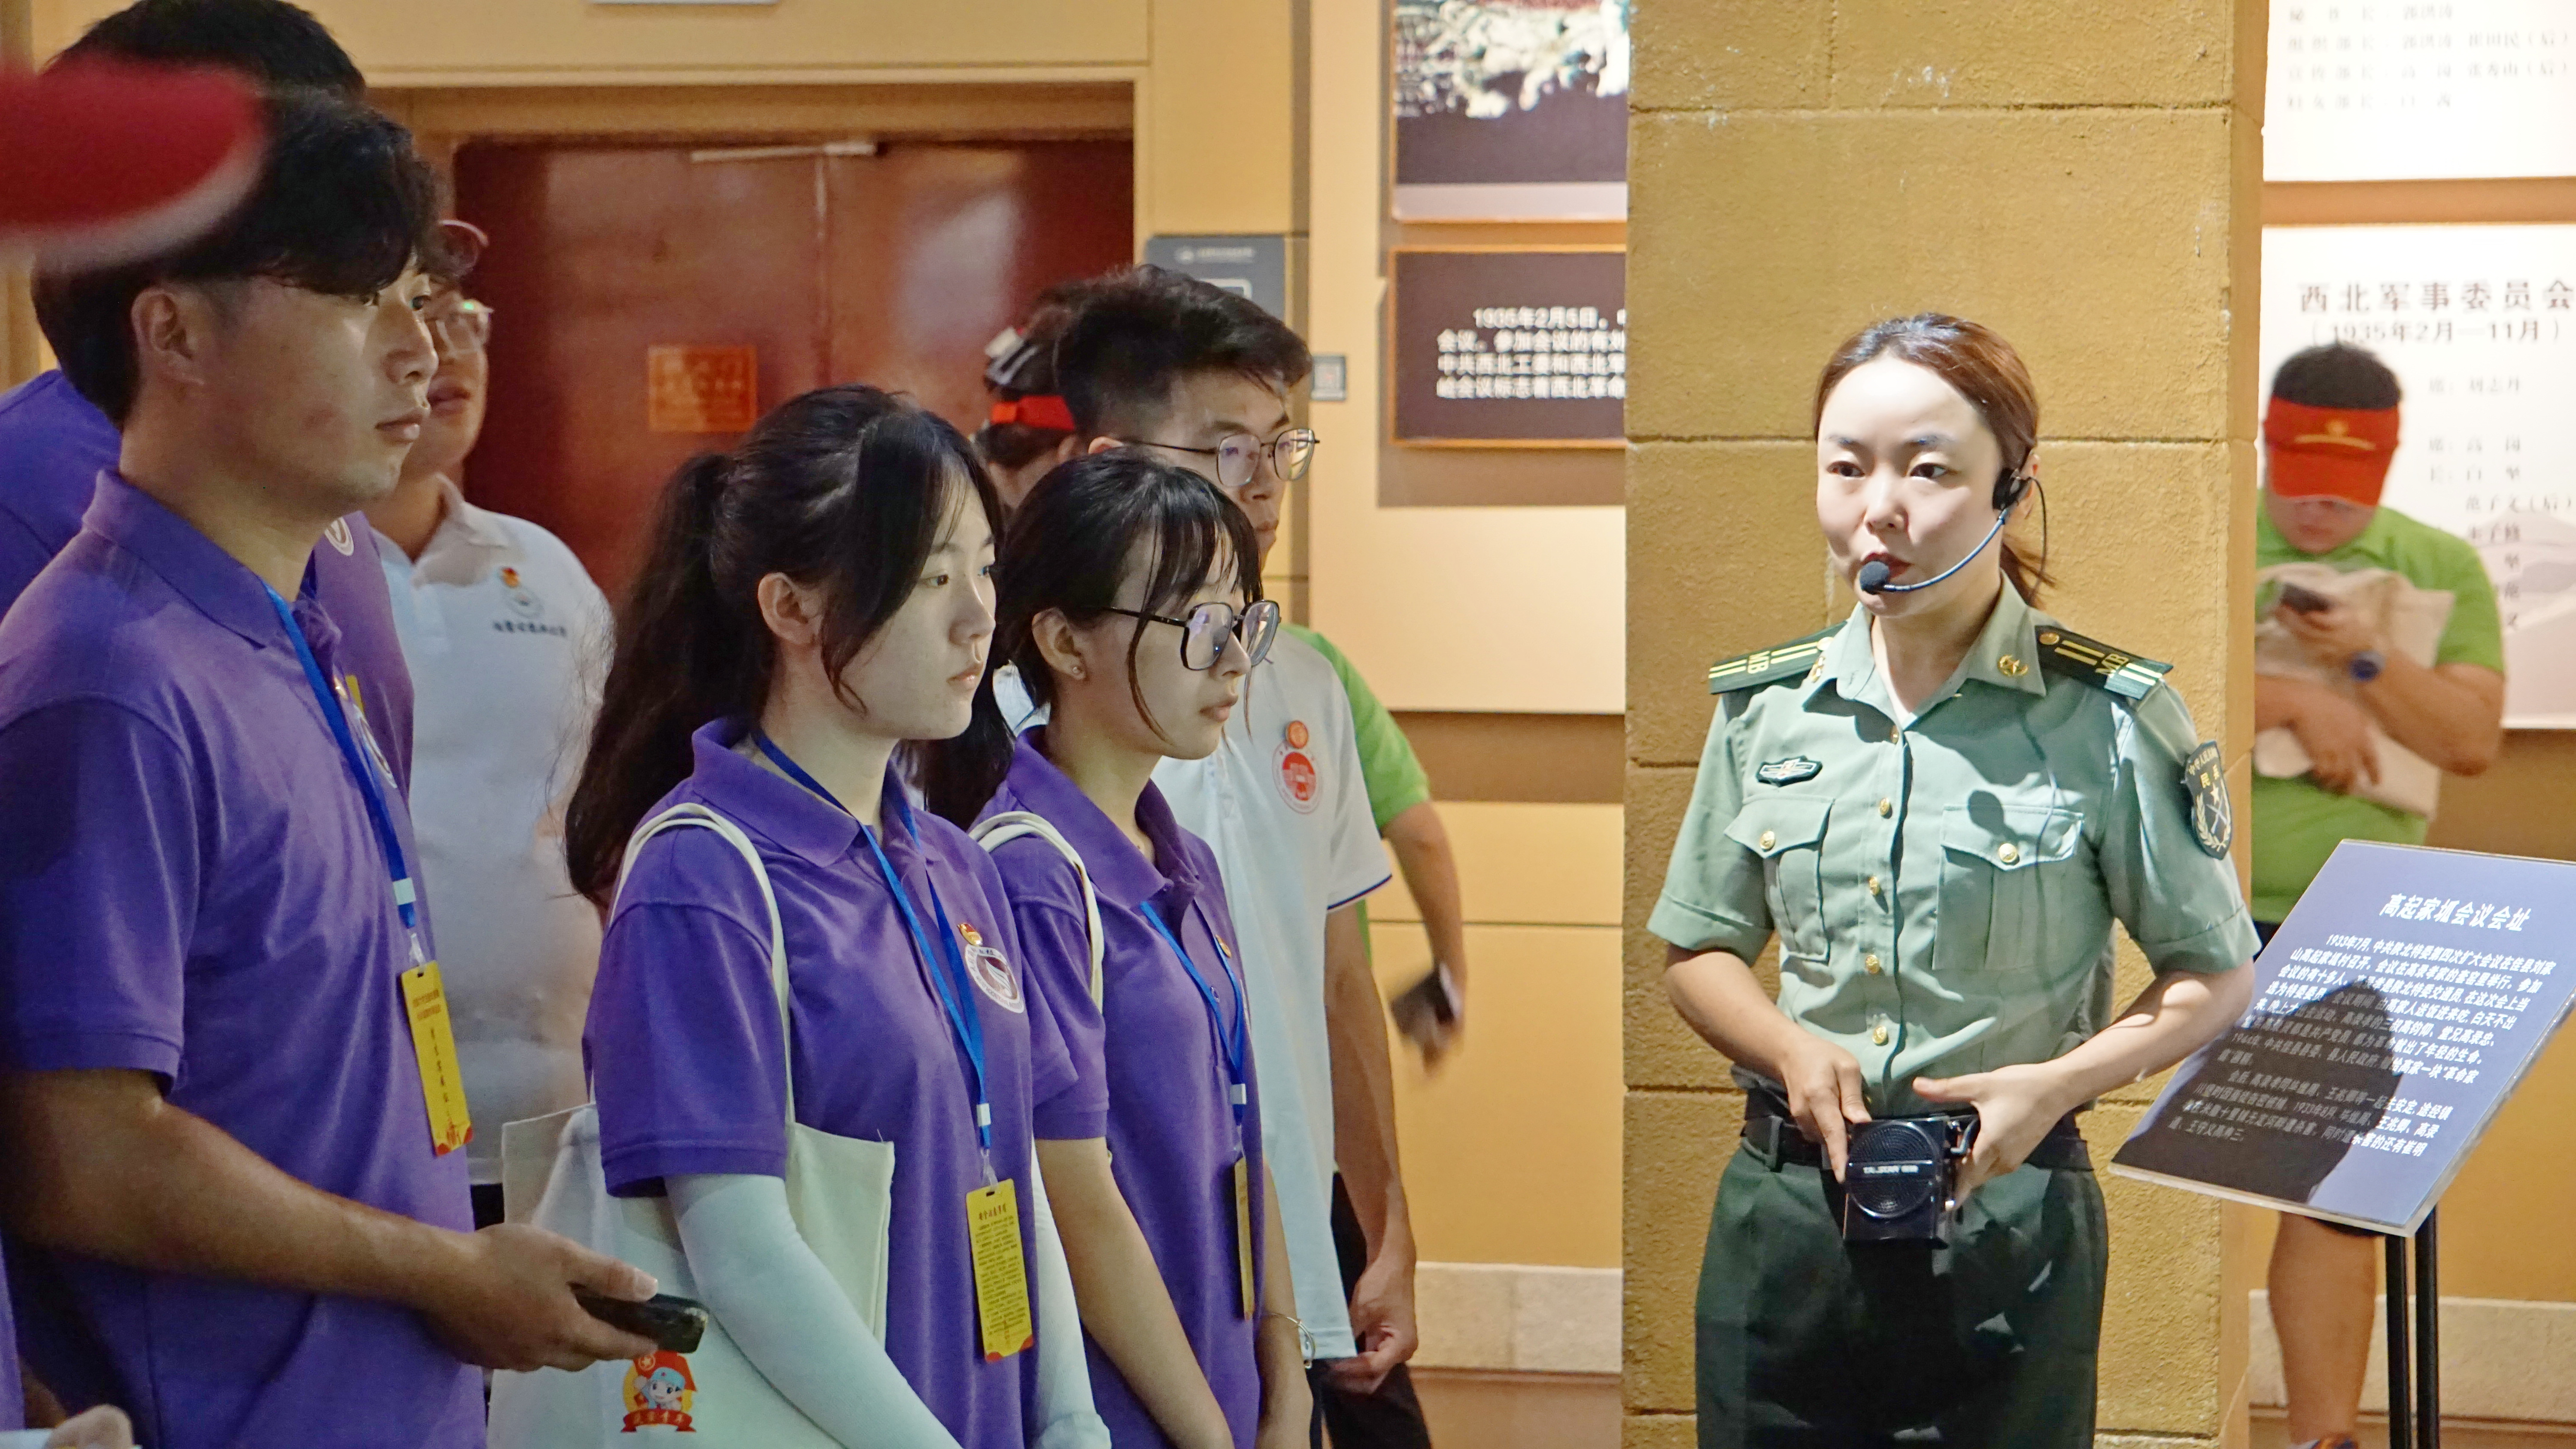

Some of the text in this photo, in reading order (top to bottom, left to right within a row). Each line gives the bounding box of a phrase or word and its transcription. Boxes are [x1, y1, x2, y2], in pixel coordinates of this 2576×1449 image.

[2300, 280, 2573, 312] 西北军事委员会
[1747, 650, 1770, 674] MB
[2095, 653, 2129, 678] MB
[2379, 893, 2531, 931] 高起家坬会议会址
